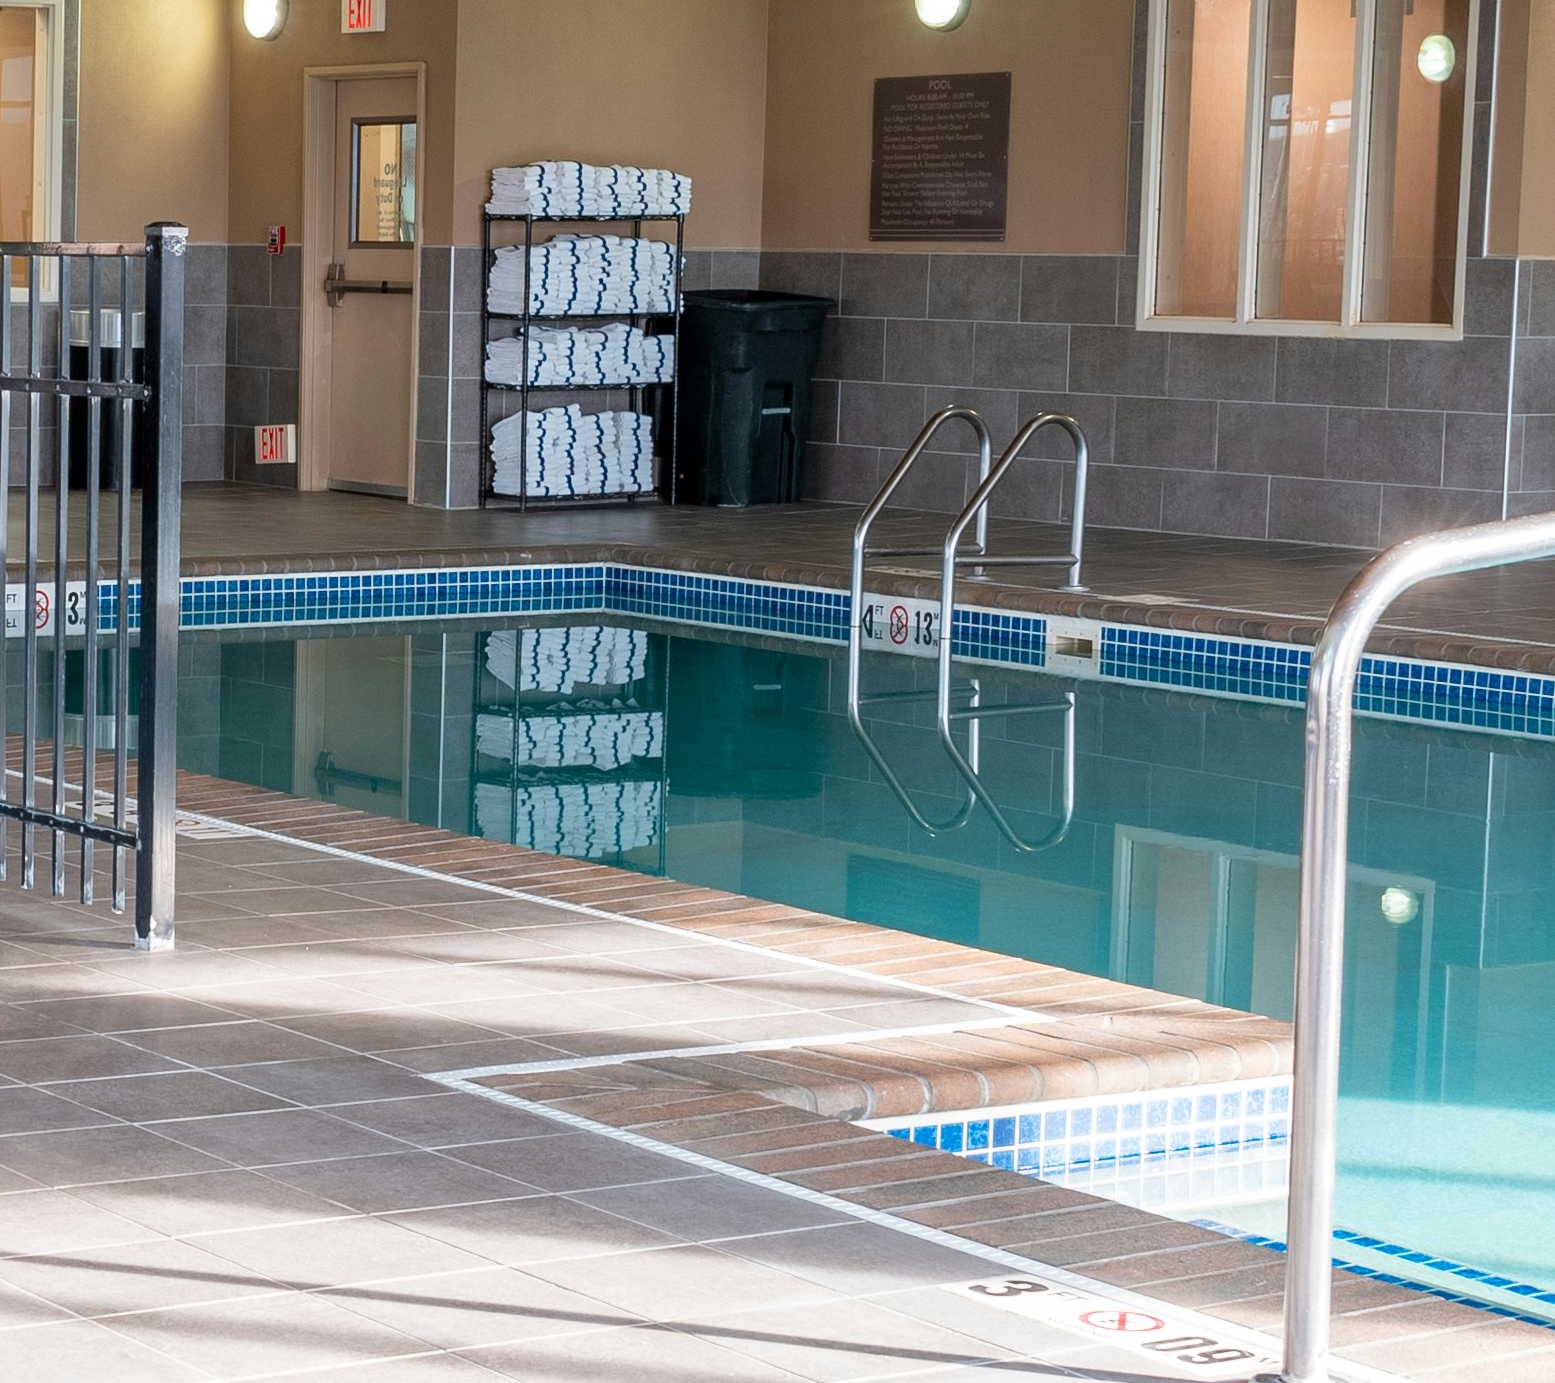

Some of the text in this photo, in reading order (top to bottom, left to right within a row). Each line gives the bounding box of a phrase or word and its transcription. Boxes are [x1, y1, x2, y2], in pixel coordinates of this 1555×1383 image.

[929, 80, 952, 90] POOL
[261, 427, 284, 459] EXIT
[6, 593, 17, 604] FT
[875, 605, 884, 616] FT
[968, 1280, 1050, 1297] 3
